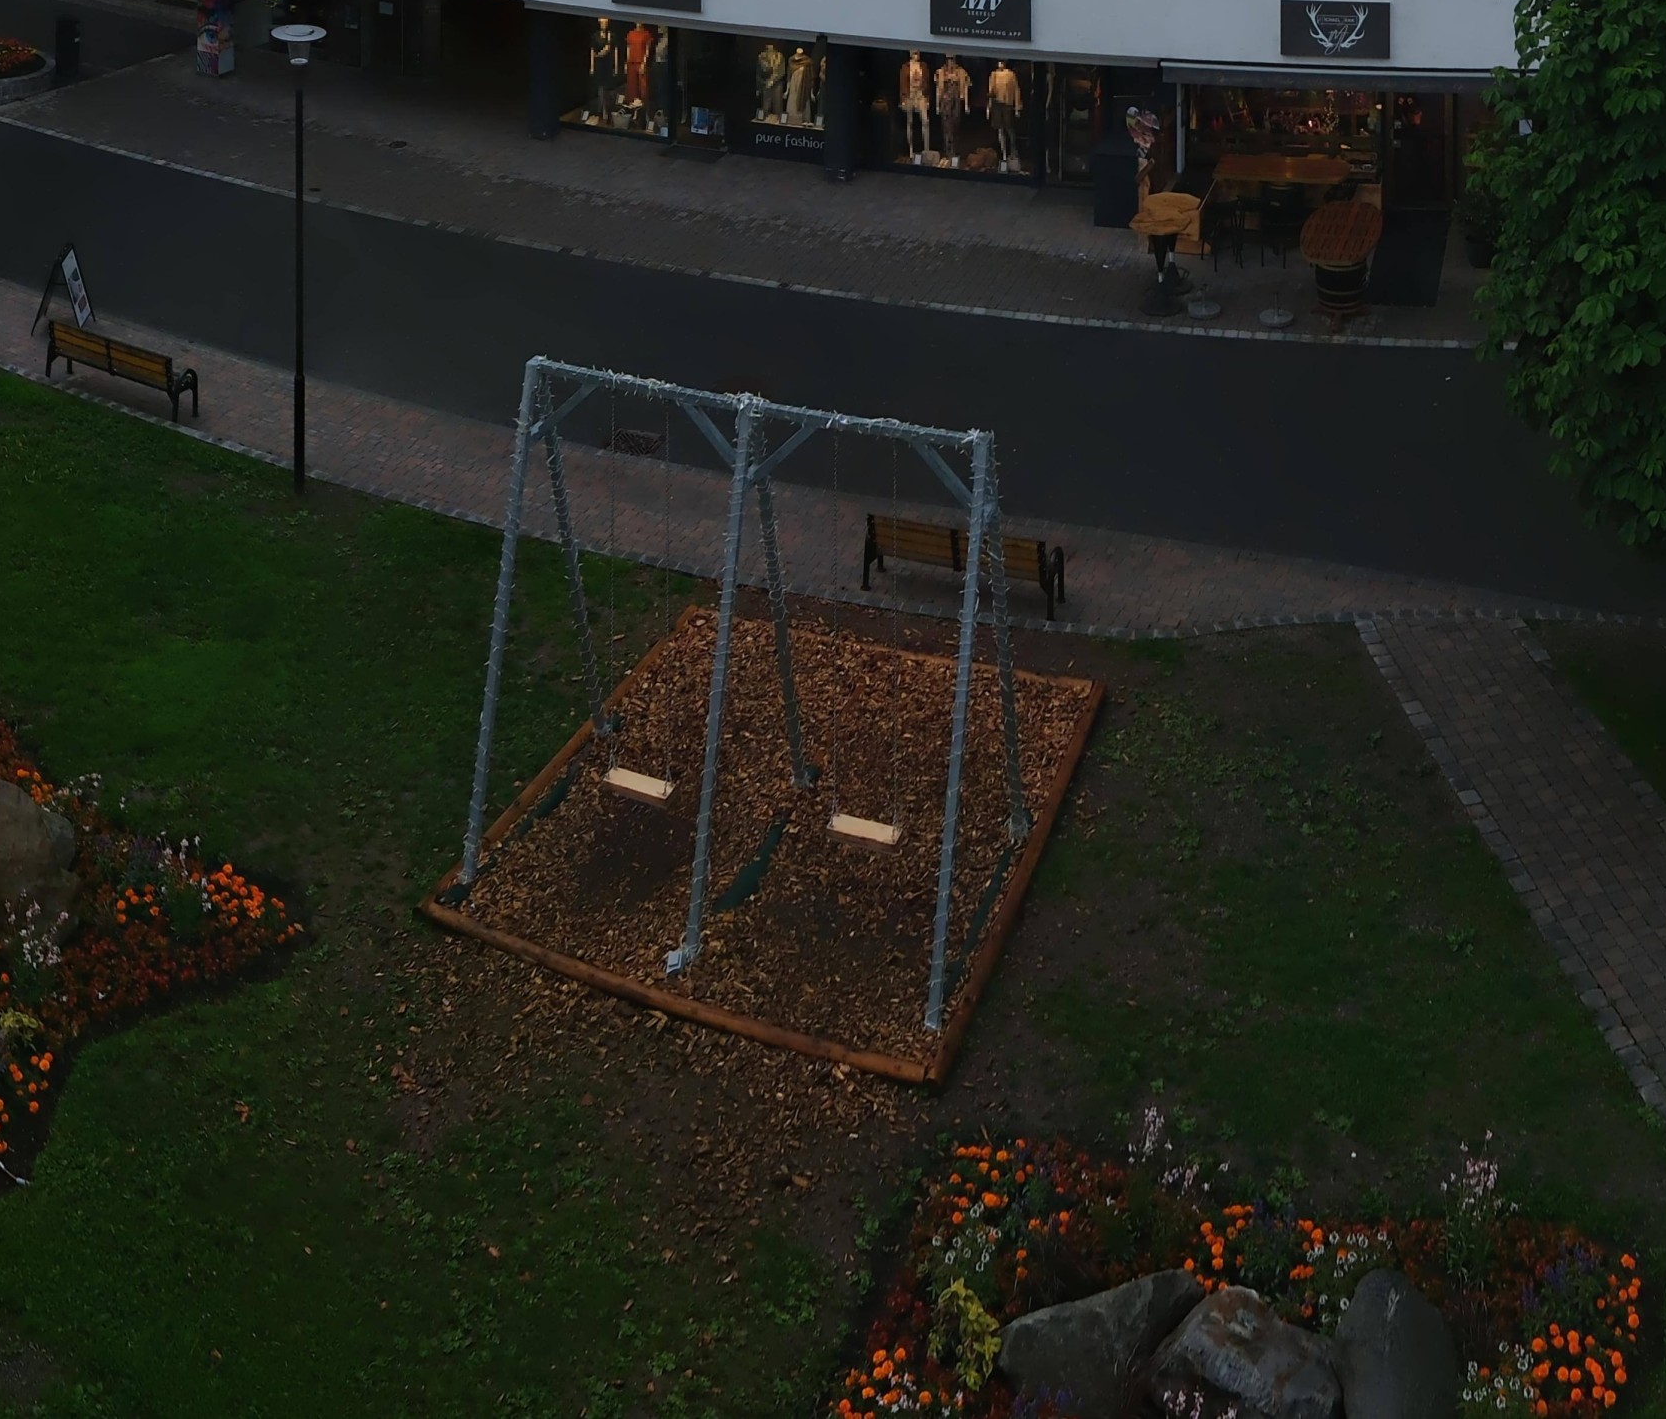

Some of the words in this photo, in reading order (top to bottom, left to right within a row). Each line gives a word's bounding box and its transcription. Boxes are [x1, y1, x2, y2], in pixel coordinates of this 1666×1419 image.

[967, 10, 996, 18] SEEFELD
[940, 26, 969, 34] SEEFELD
[971, 27, 1006, 36] SHOPPING
[755, 132, 781, 145] pure
